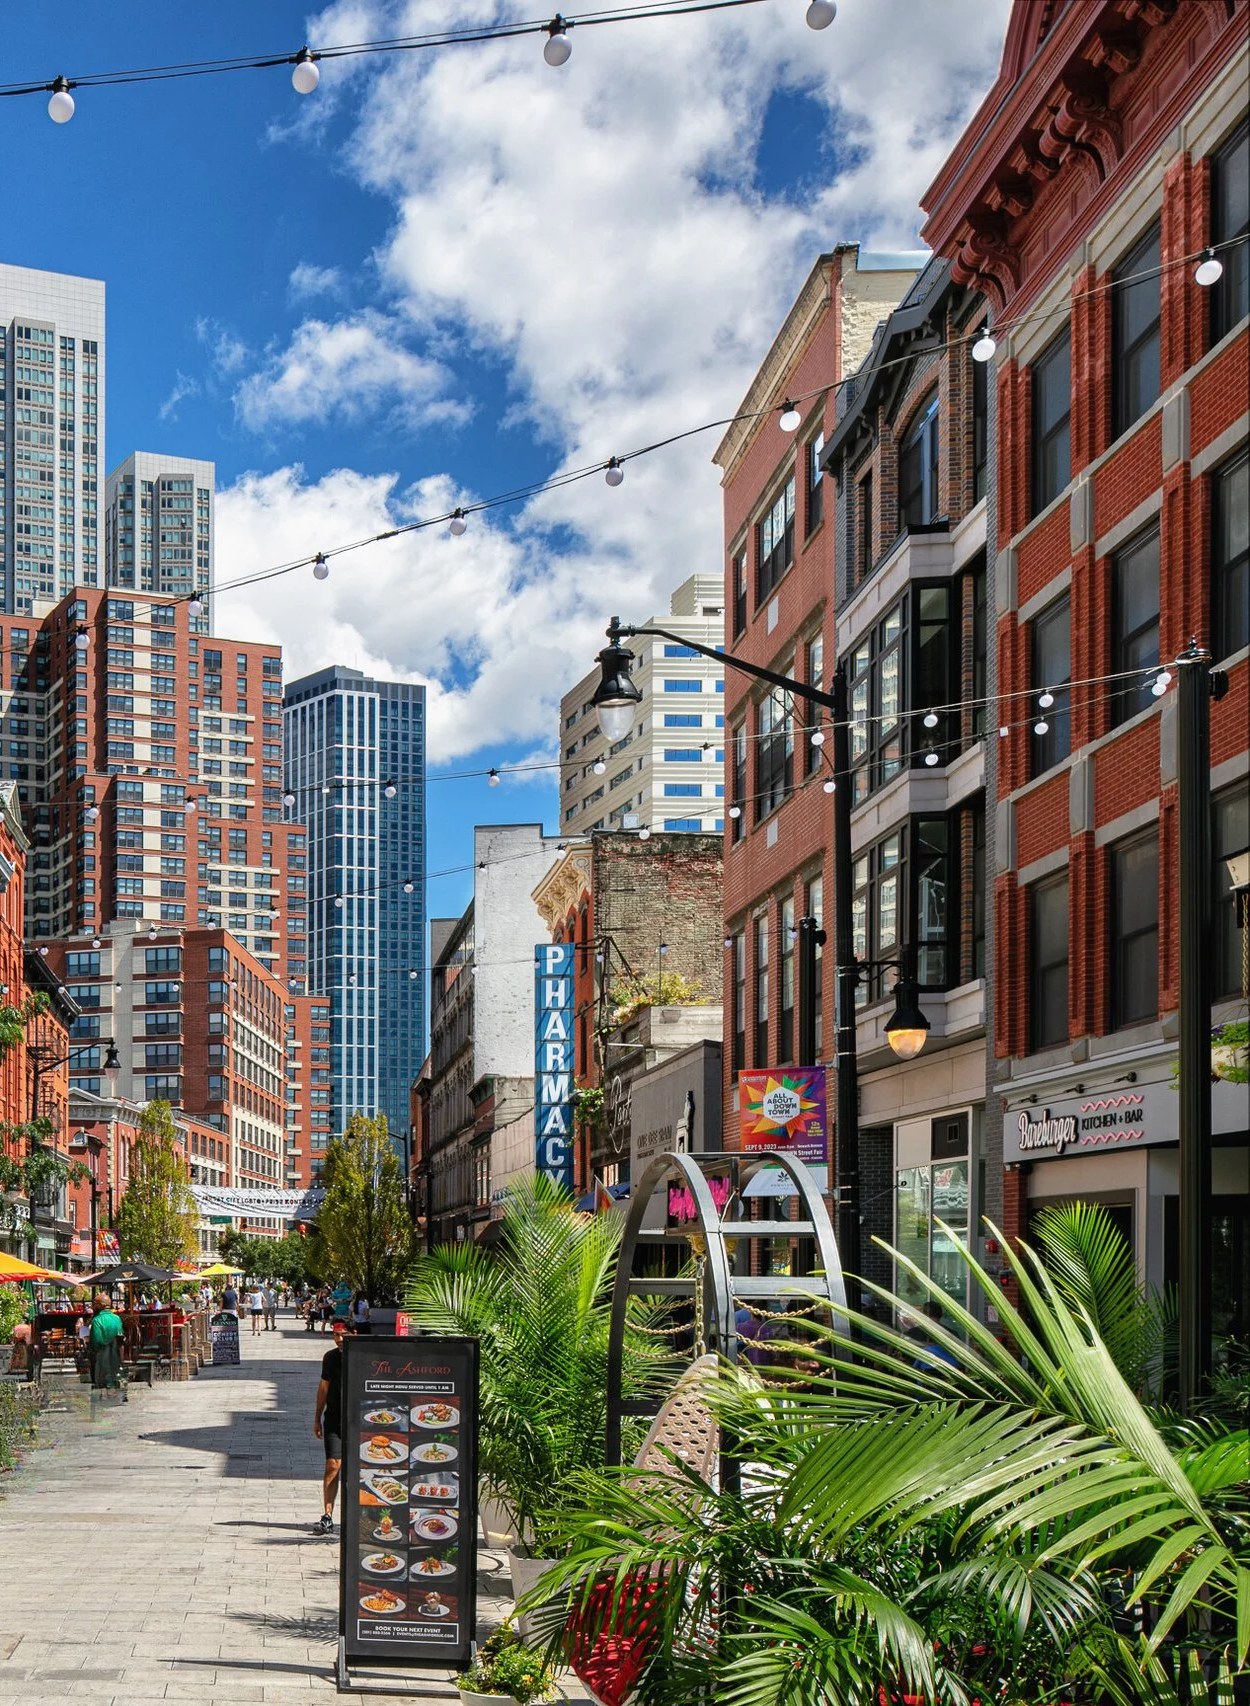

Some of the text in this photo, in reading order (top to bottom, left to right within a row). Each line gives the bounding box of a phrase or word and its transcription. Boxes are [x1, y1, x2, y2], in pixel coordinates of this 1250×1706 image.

[541, 946, 569, 1190] PHARMACY
[774, 1102, 798, 1110] DOWN
[1018, 1109, 1078, 1154] Bareburger
[1081, 1113, 1118, 1130] KITCHEN
[1125, 1108, 1143, 1123] BAR
